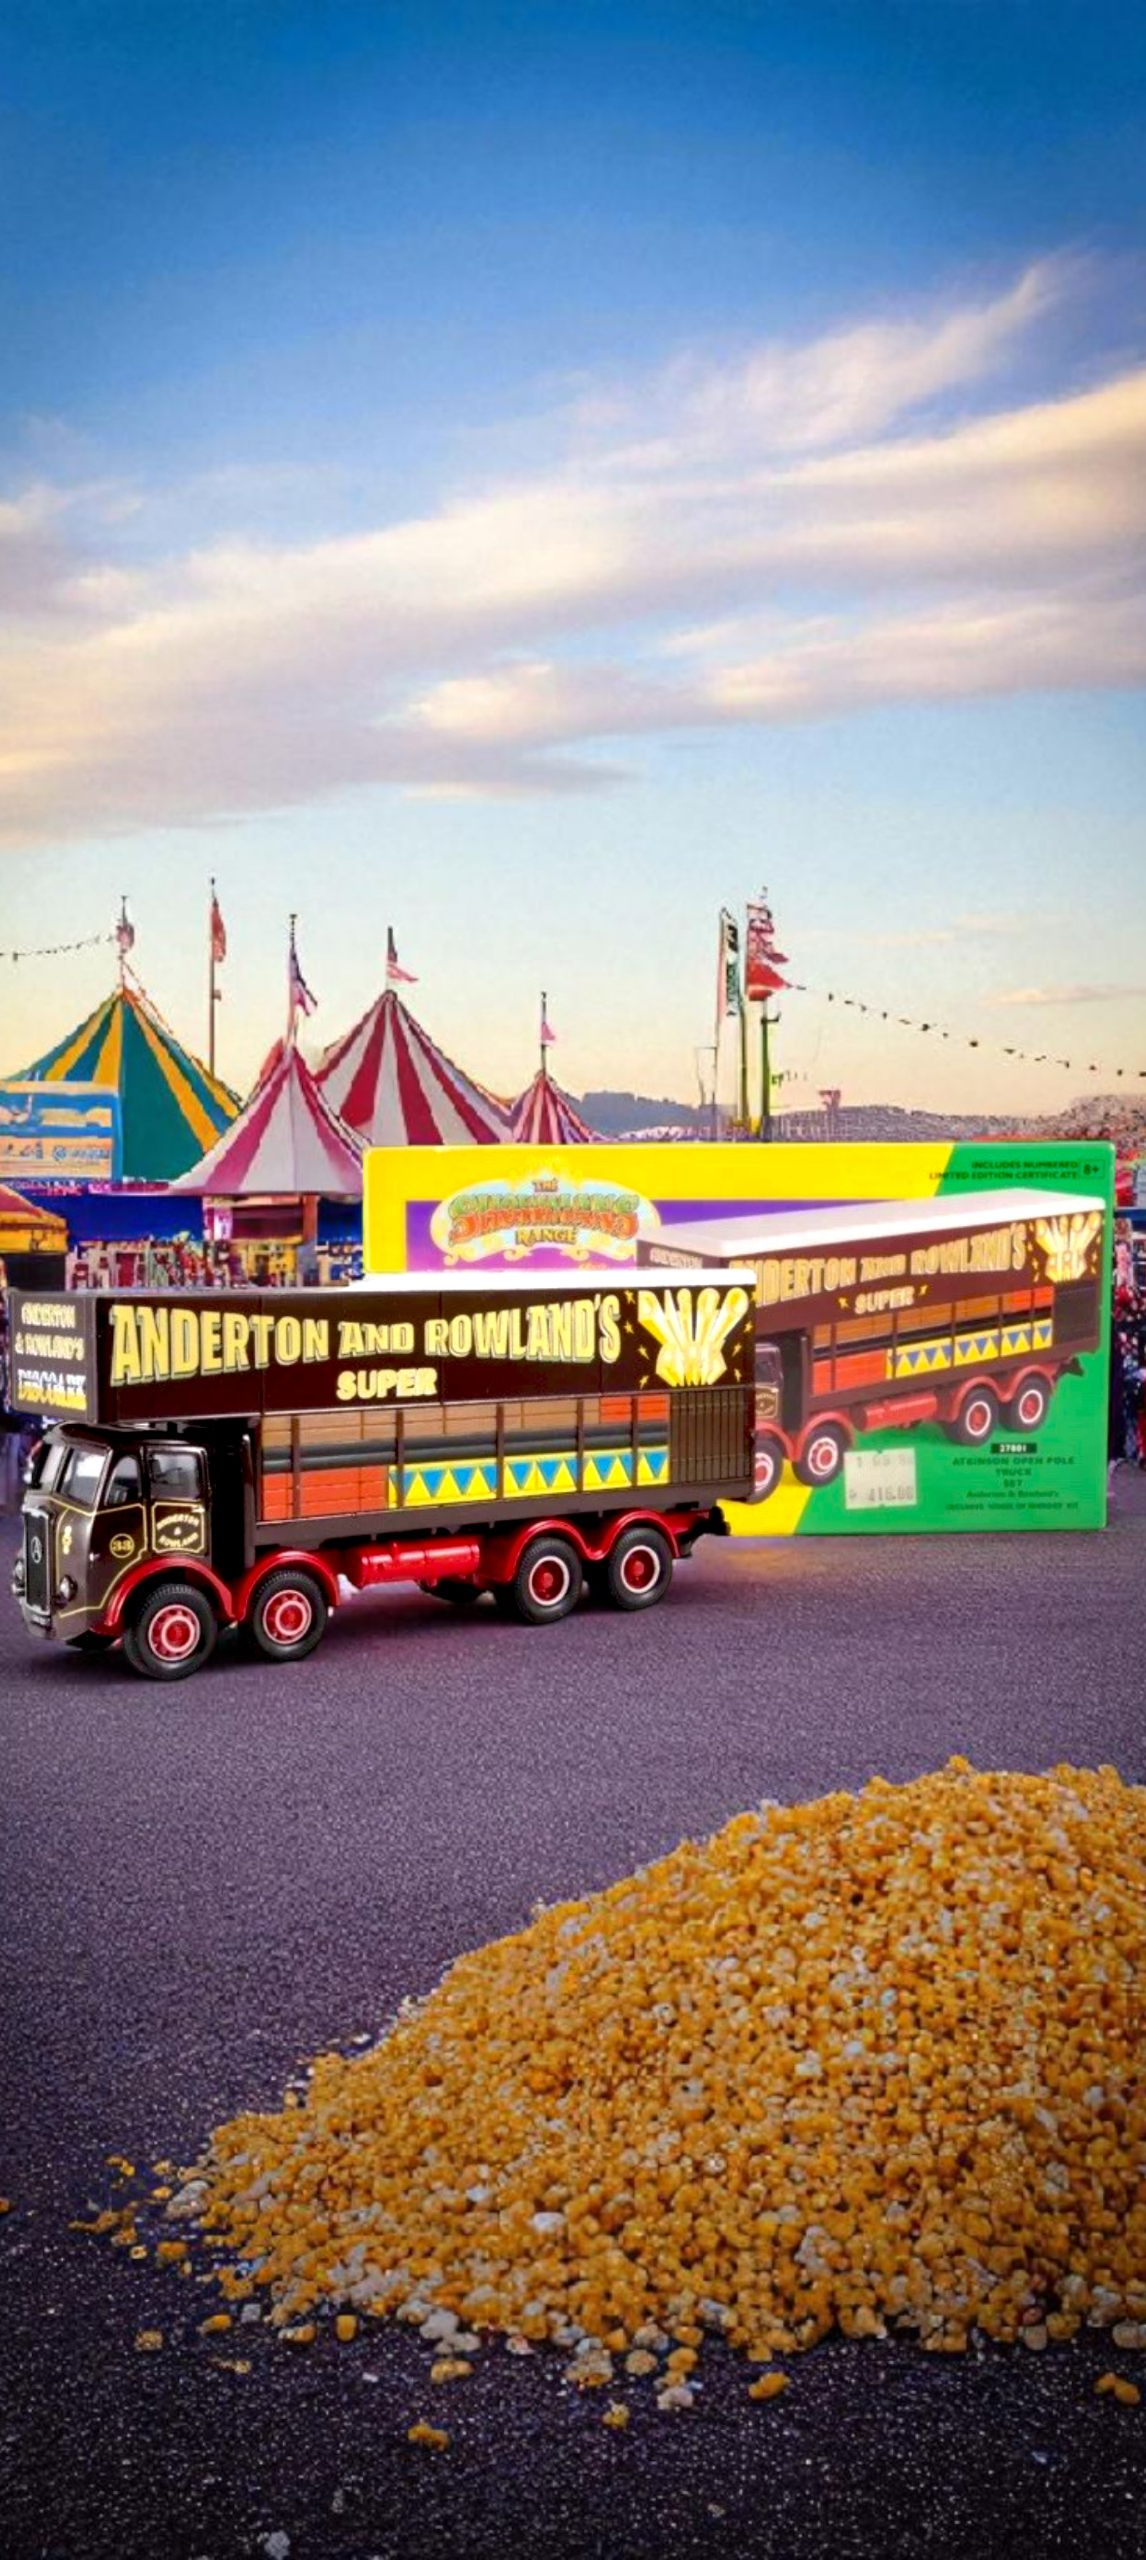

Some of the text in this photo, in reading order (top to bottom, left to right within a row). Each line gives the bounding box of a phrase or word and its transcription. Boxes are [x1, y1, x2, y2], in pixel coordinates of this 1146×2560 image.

[972, 1160, 1079, 1169] INCLUDES NUMBERED
[929, 1171, 1078, 1180] LIMITED EDITION CERTIFICATE
[532, 1178, 560, 1193] THE
[515, 1227, 579, 1247] RANGE
[911, 1222, 1028, 1275] ROWLAND'S
[855, 1286, 915, 1315] SUPER
[109, 1294, 621, 1387] ANDERTON AND ROWLAND'S
[336, 1367, 438, 1401] SUPER
[1046, 1455, 1075, 1465] POLE
[995, 1468, 1032, 1477] TRUCK
